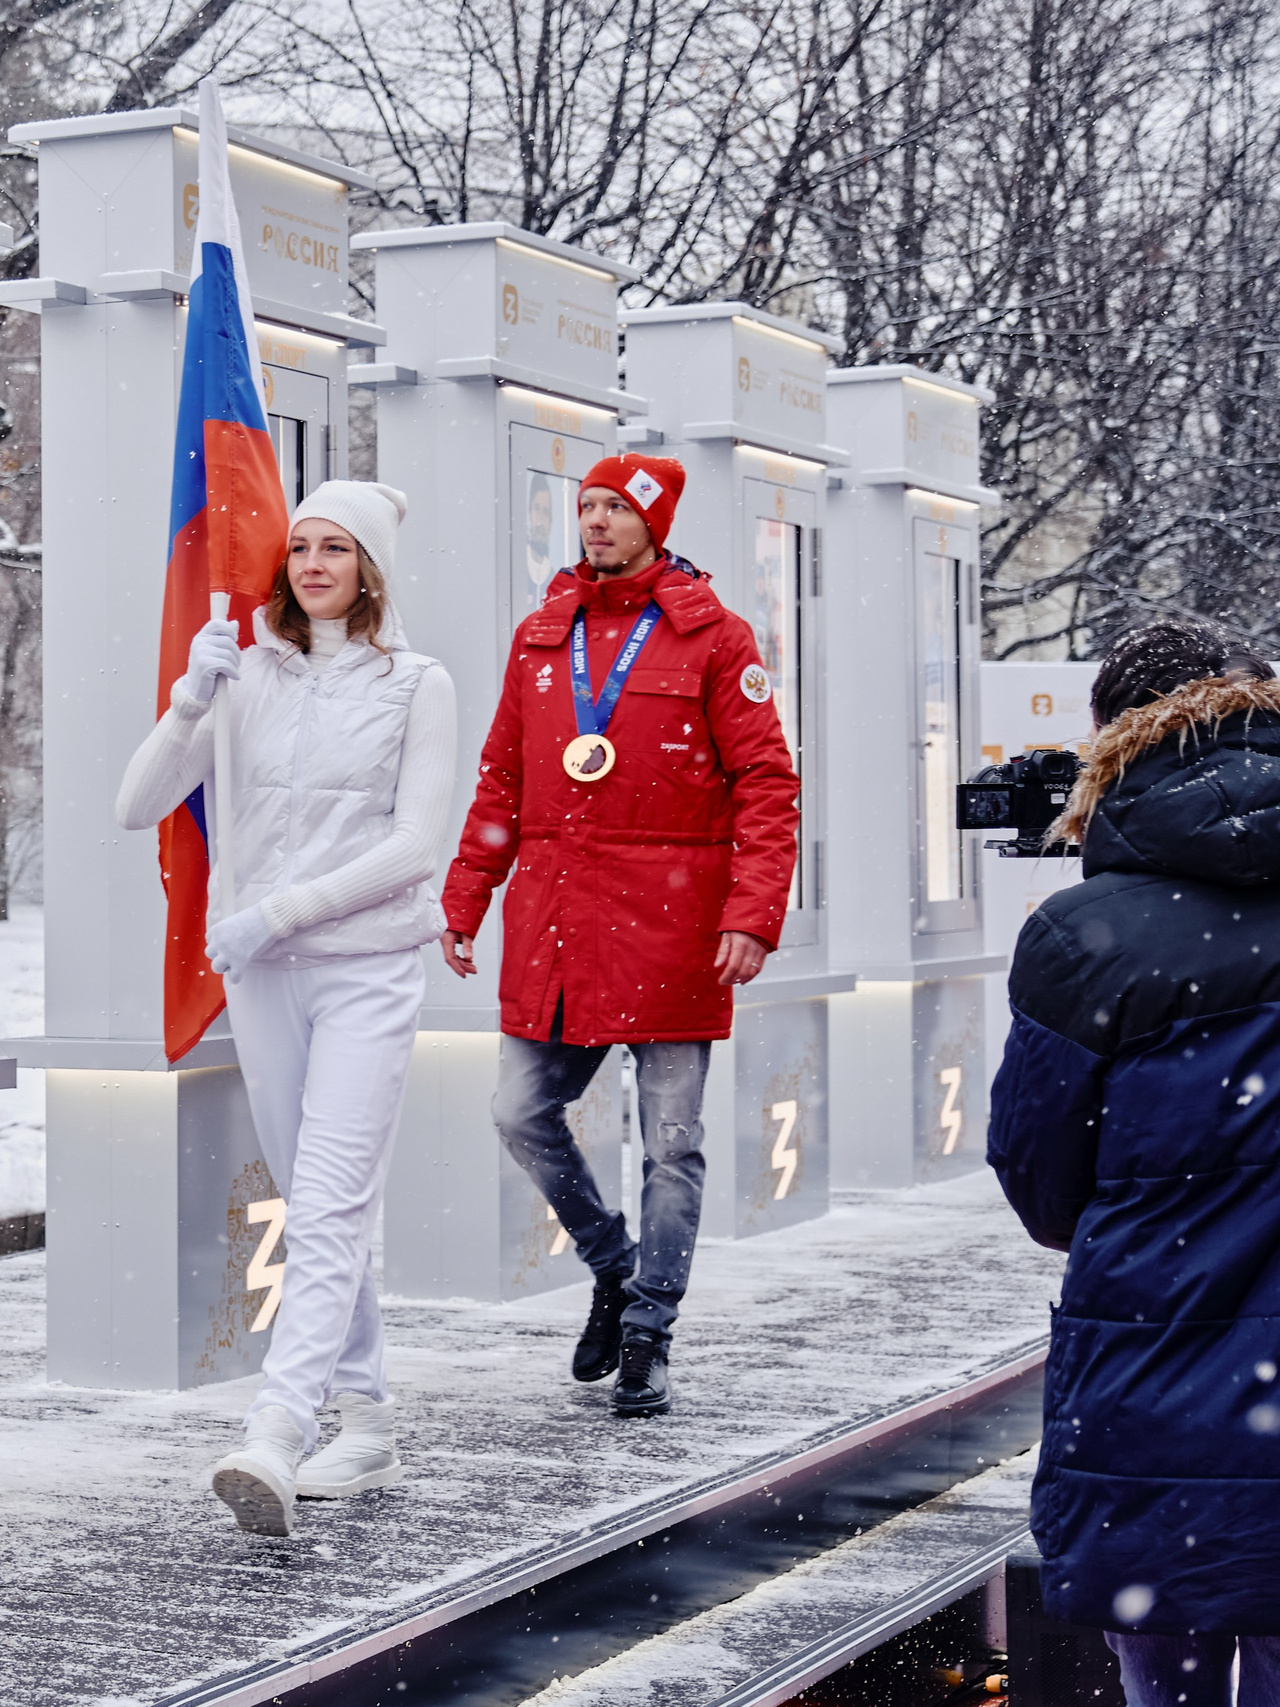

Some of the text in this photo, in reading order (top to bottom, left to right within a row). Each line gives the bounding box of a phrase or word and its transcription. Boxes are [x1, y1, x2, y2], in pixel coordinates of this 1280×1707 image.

[262, 224, 340, 274] РОССИЯ
[275, 344, 307, 371] СПОРТ
[574, 621, 586, 675] SOCHI 2014
[616, 618, 654, 673] SOCHI 2014
